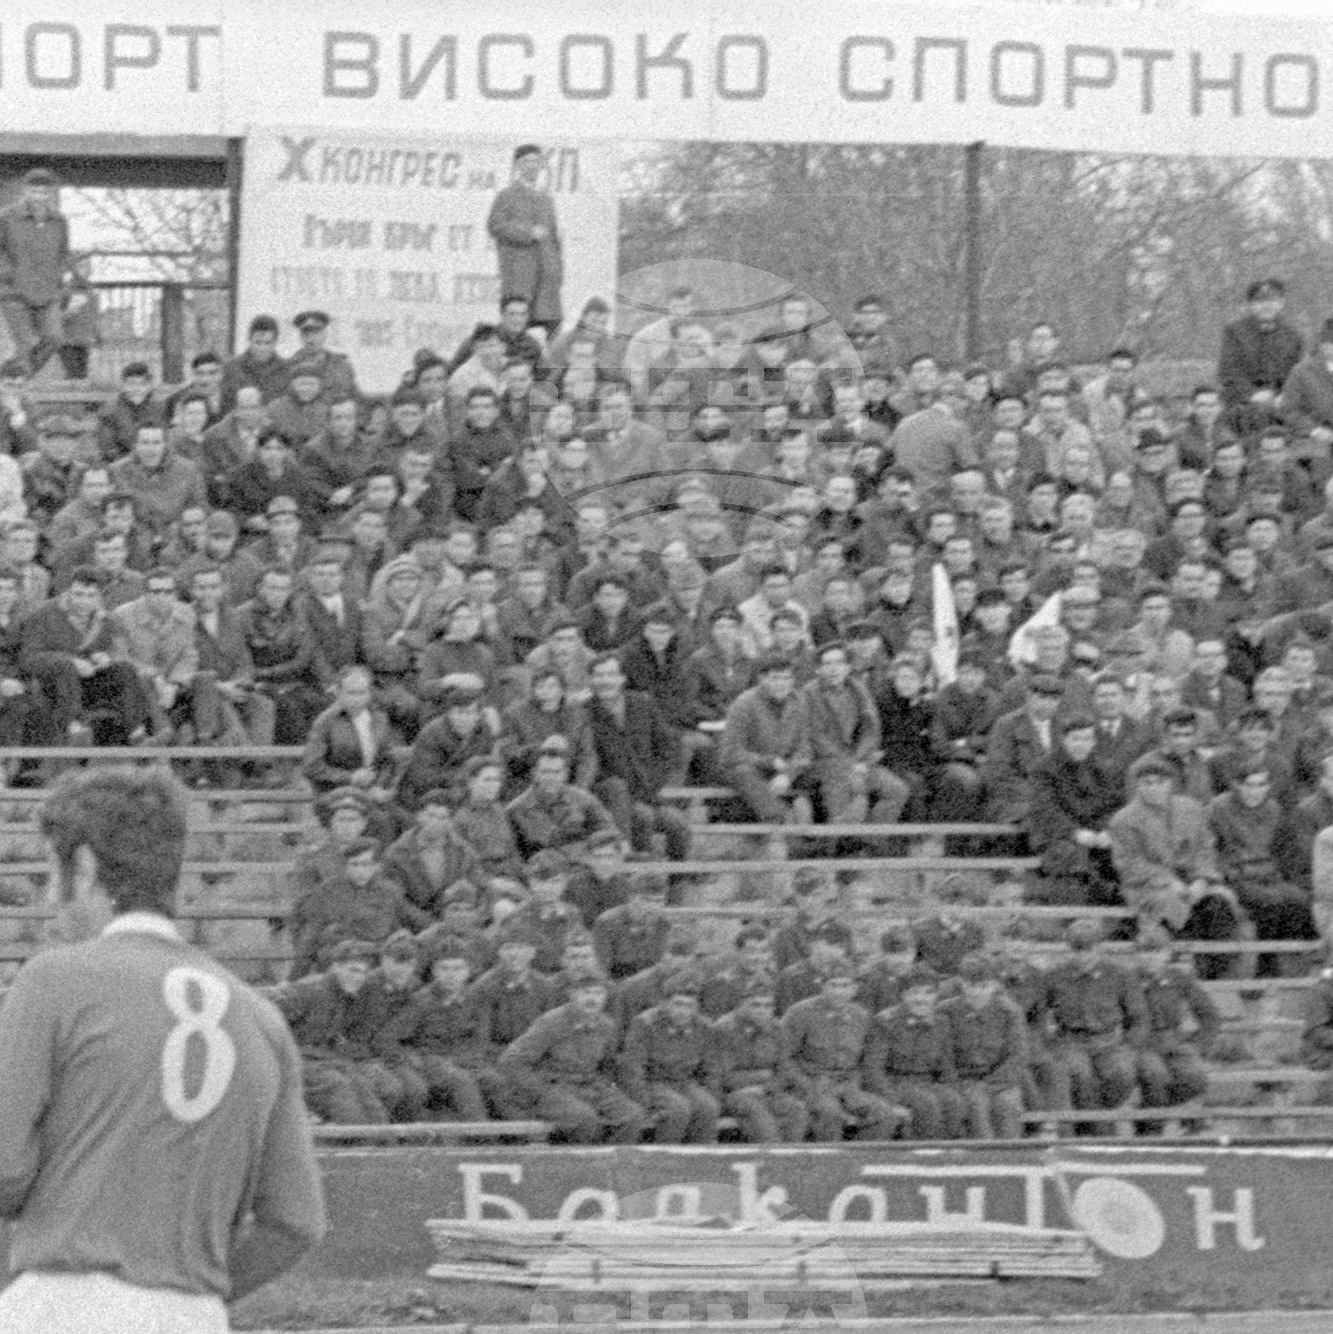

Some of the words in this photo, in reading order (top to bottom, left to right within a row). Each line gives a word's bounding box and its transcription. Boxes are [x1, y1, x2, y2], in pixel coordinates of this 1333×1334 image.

[320, 30, 770, 102] ВИСОКО
[837, 33, 1320, 119] СПОРТНО
[319, 145, 463, 190] КОНГРЕС
[161, 966, 237, 1124] 8
